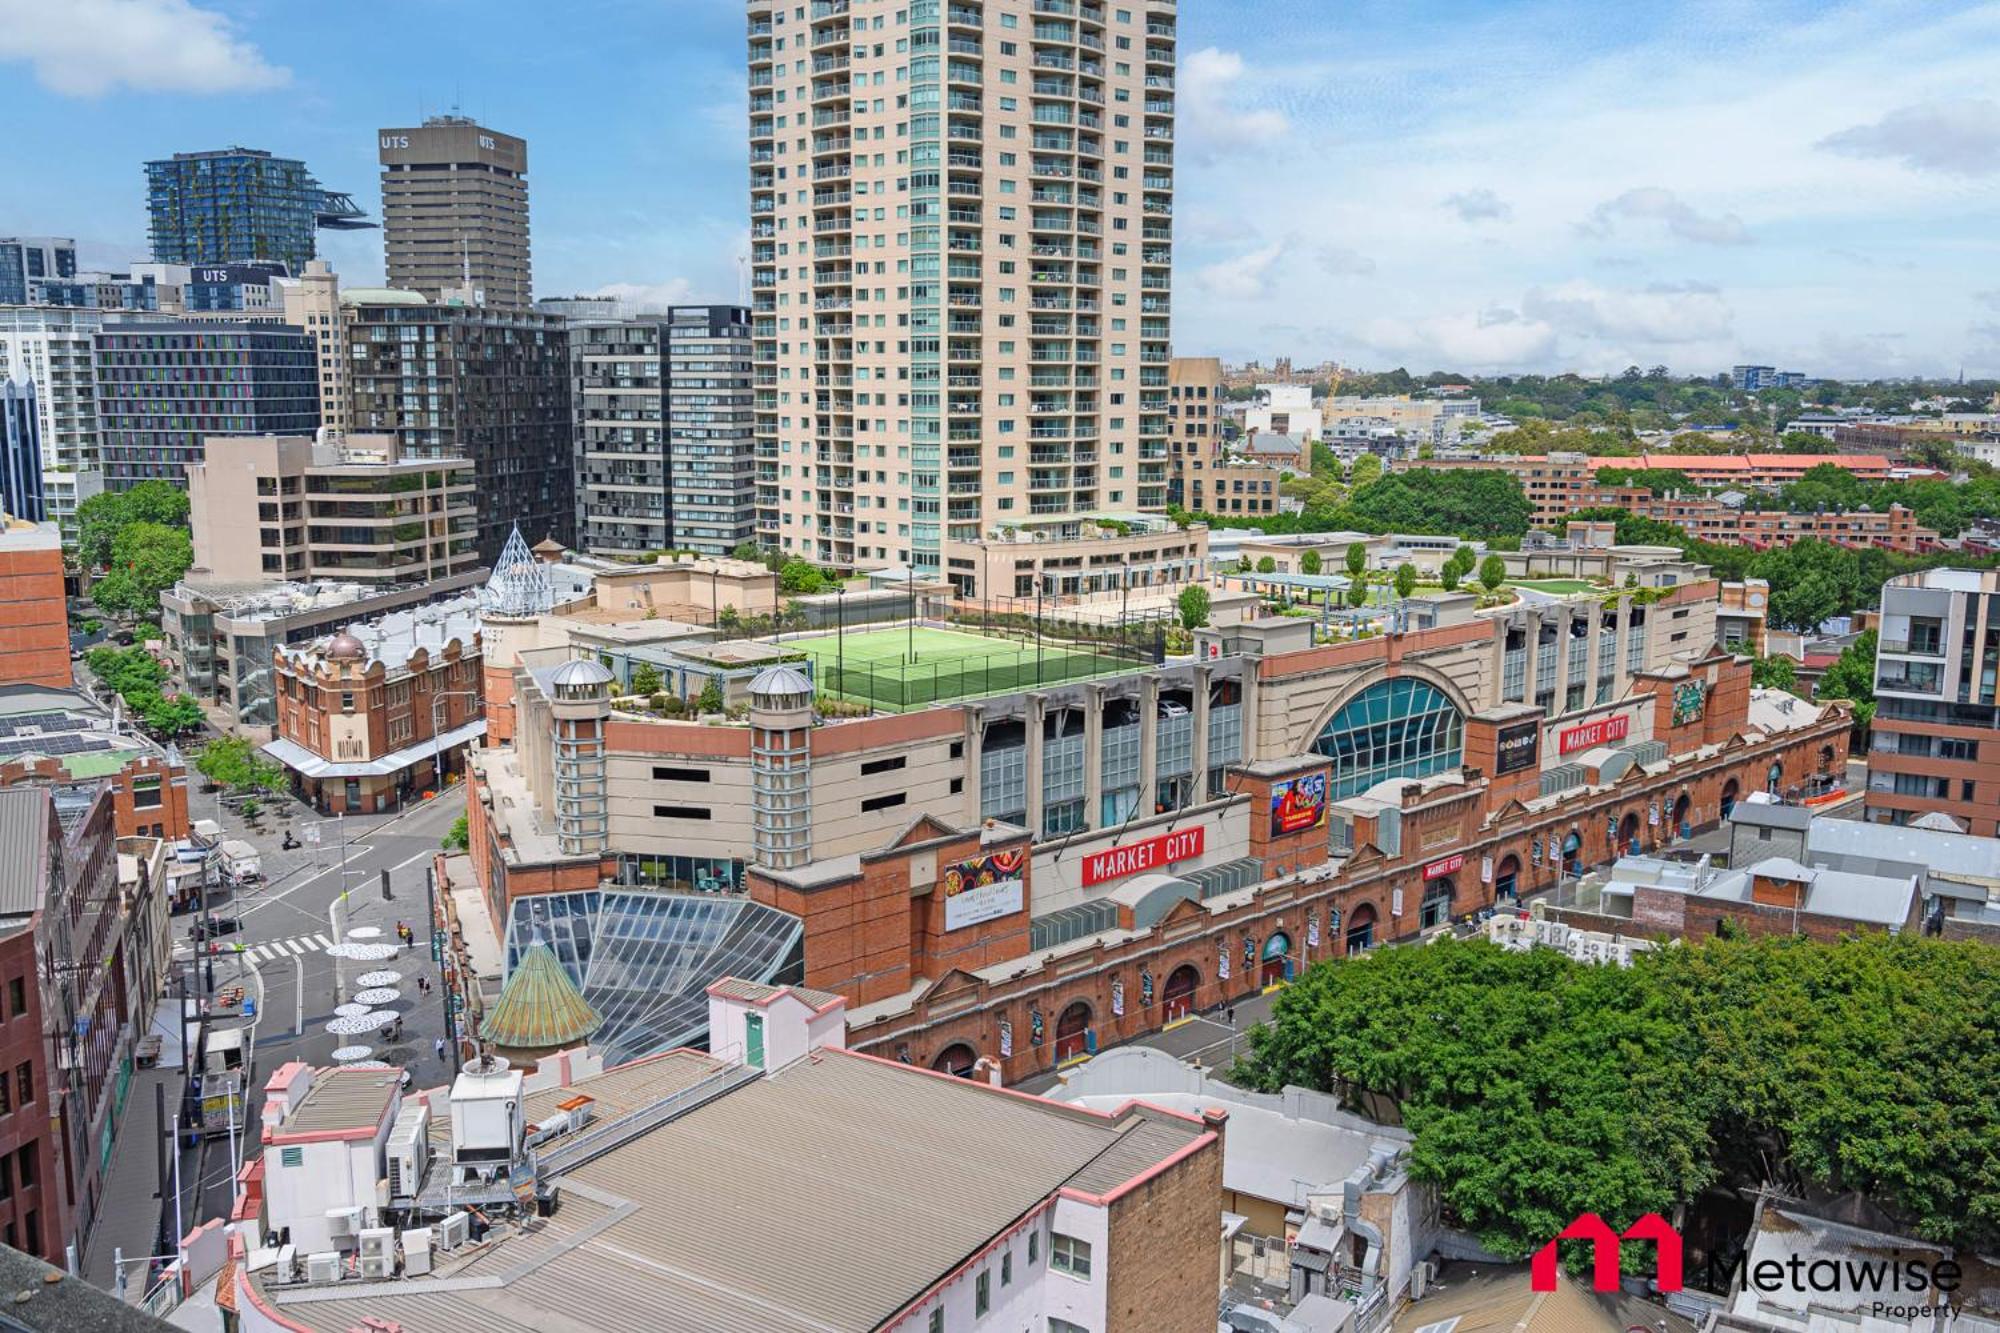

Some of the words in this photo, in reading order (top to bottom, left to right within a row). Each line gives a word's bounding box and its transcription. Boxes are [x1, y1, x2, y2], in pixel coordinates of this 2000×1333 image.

[381, 136, 409, 149] UTS
[479, 134, 496, 150] UTS
[203, 269, 228, 282] UTS
[1565, 724, 1602, 751] MARKET
[1606, 718, 1626, 739] CITY
[1092, 842, 1155, 880] MARKET
[1166, 831, 1198, 860] CITY
